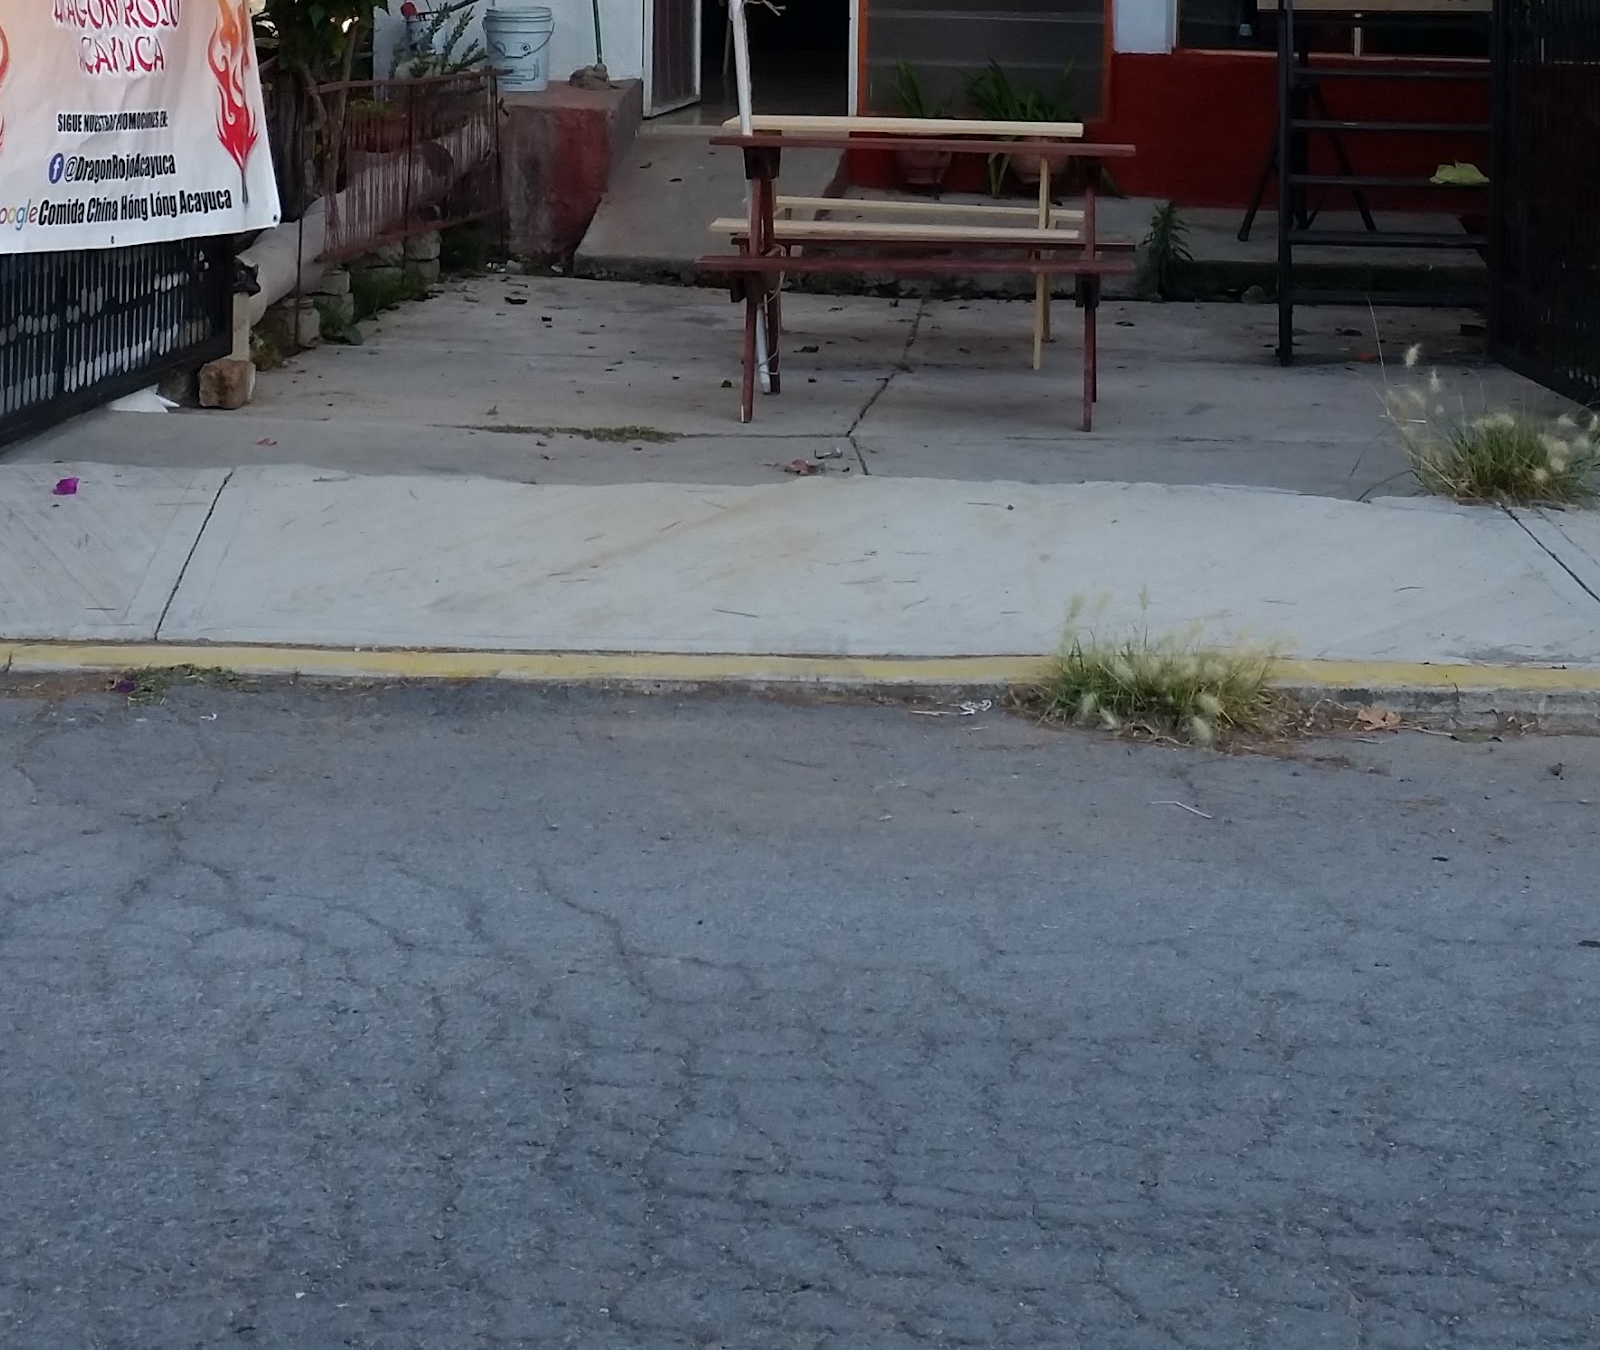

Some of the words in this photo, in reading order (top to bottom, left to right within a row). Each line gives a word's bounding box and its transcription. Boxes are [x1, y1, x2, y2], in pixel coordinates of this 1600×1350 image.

[57, 113, 82, 132] SIGUE
[64, 153, 176, 184] @DragonRojoAcayuca
[38, 198, 84, 226] Comida
[87, 197, 118, 223] China
[179, 188, 232, 215] Acayuca
